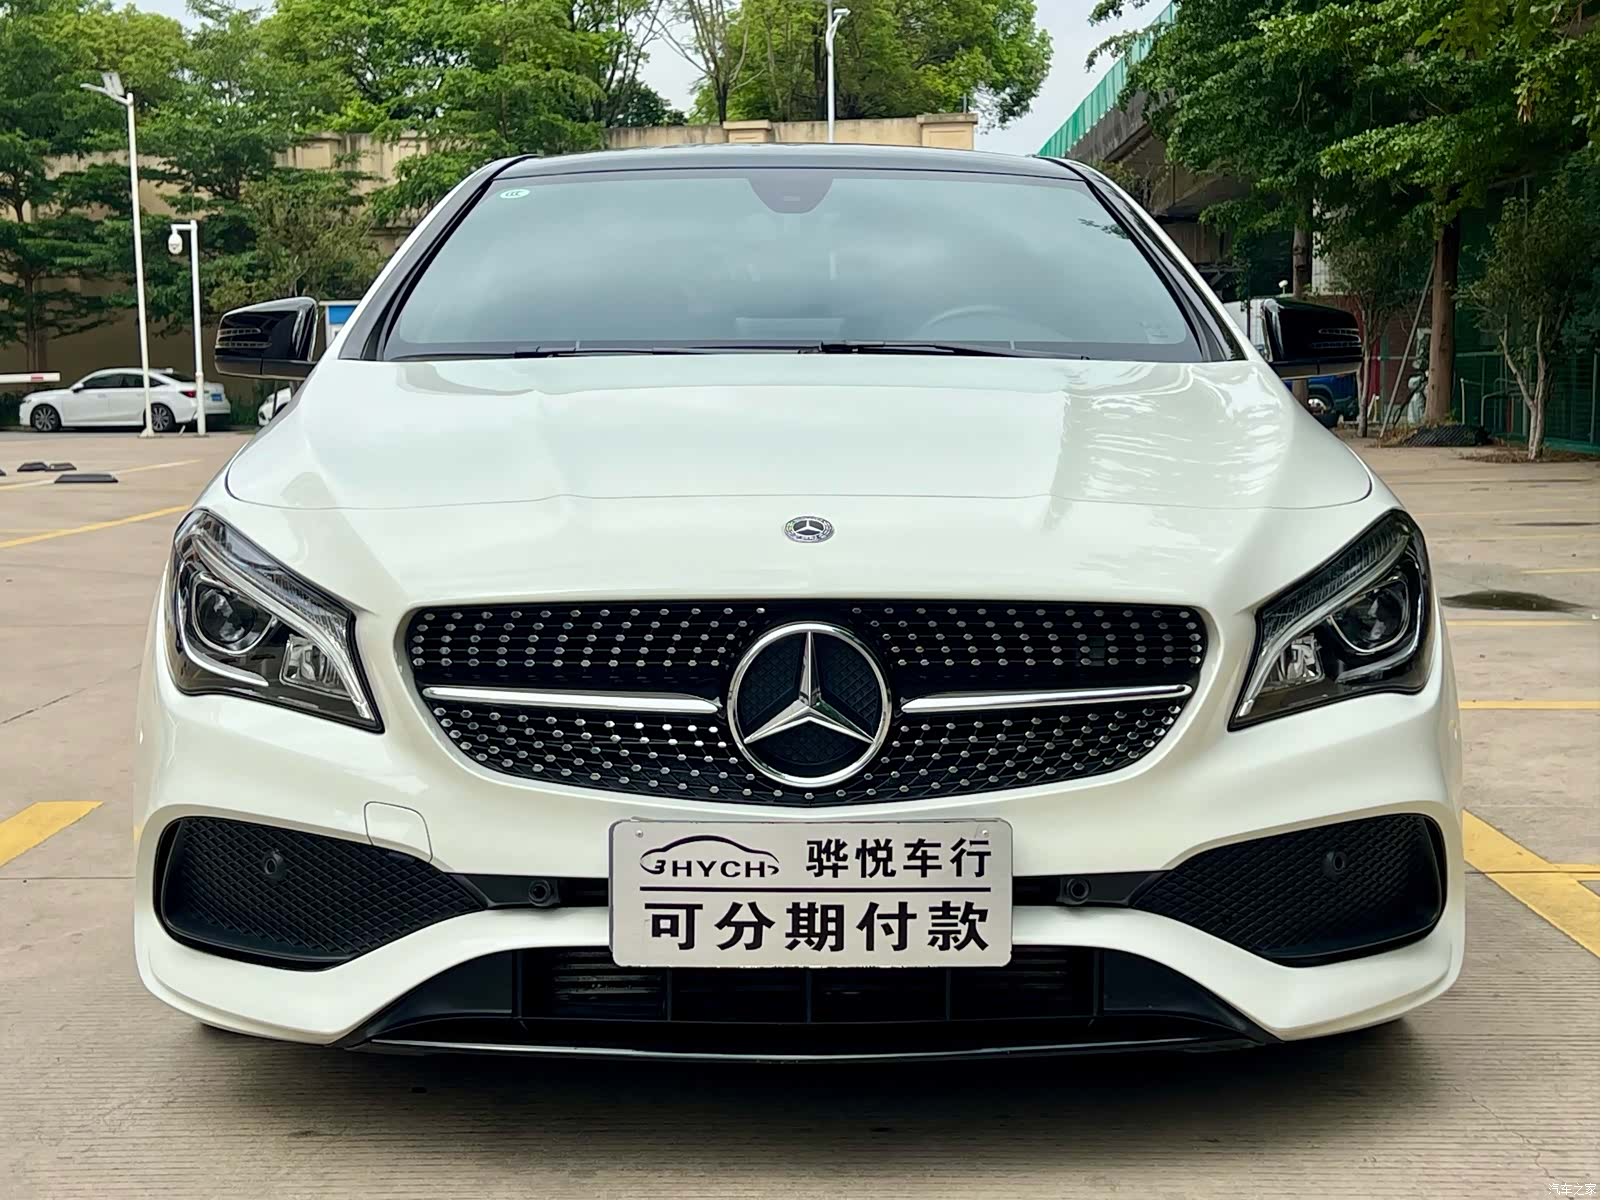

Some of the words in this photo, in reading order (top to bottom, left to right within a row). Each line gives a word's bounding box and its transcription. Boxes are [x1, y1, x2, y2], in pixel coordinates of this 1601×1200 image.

[806, 838, 991, 878] 骅悦车行
[644, 901, 989, 951] 可分期付款
